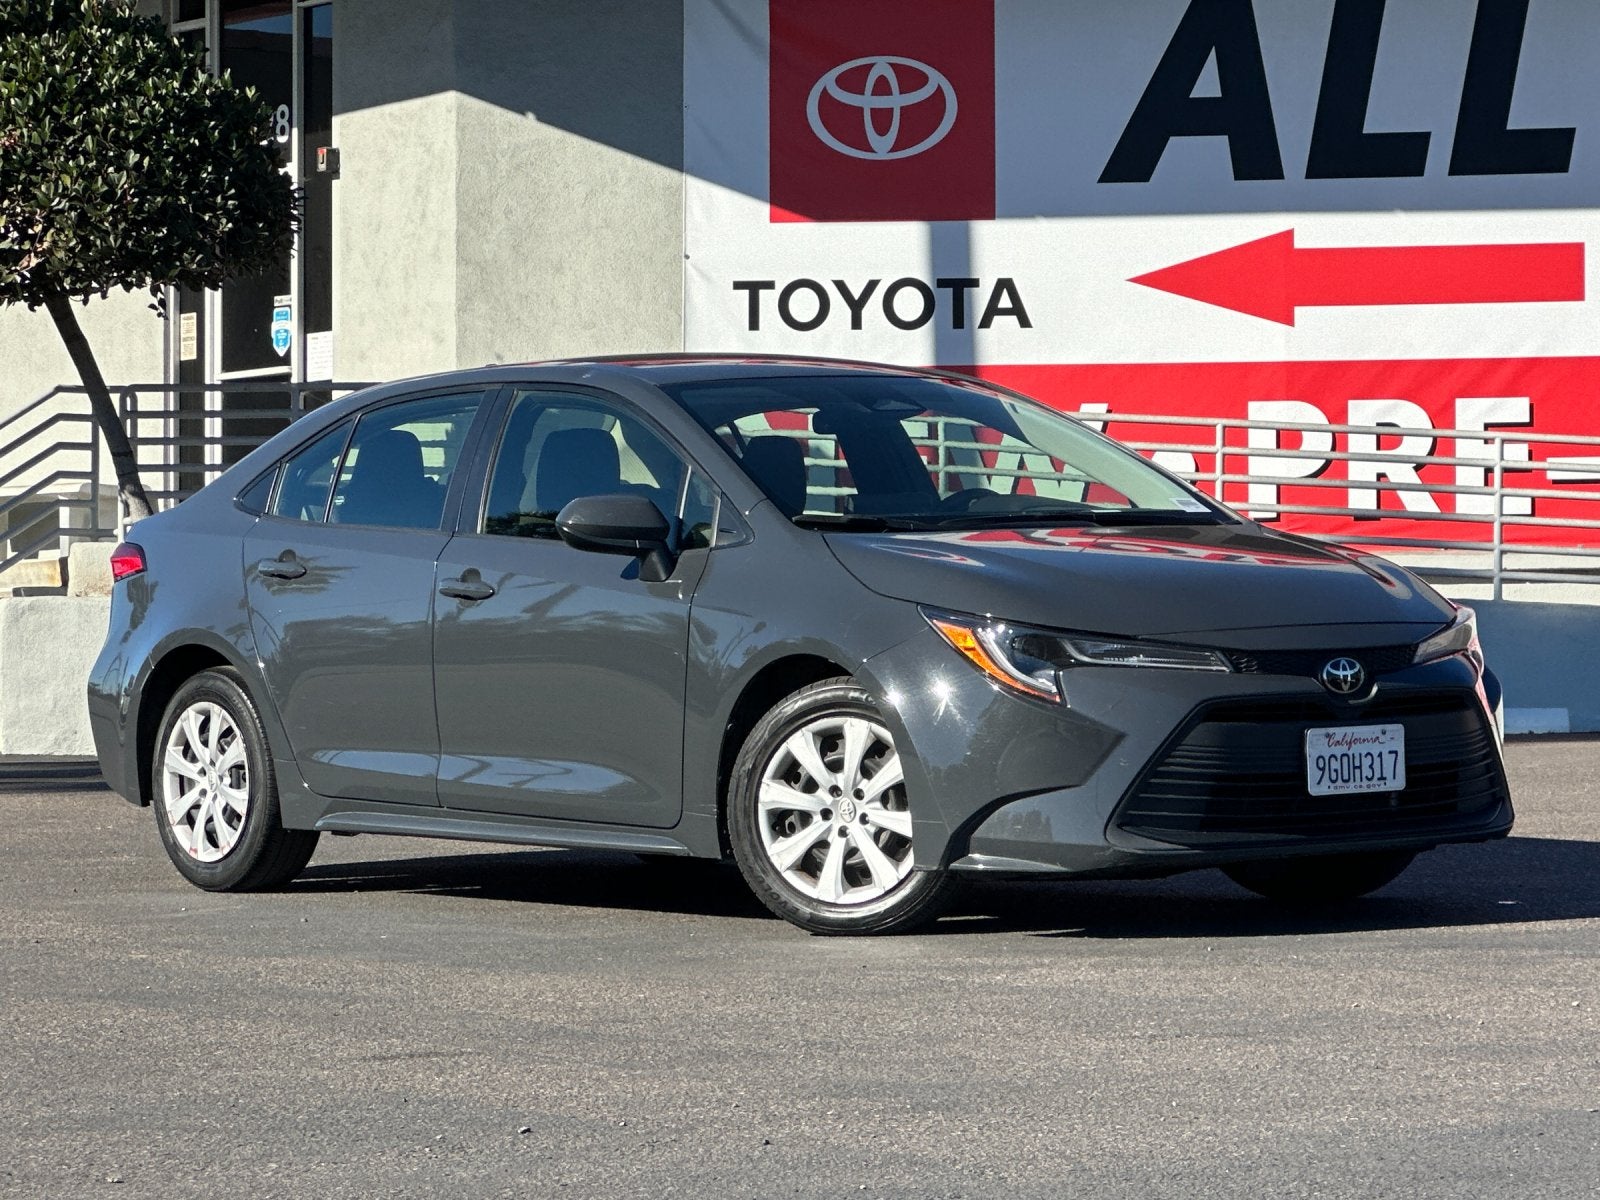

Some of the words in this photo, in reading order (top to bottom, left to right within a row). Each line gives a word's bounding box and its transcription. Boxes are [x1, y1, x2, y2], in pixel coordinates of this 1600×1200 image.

[1097, 0, 1577, 183] ALL
[732, 277, 1034, 332] TOYOTA
[1327, 732, 1386, 751] California
